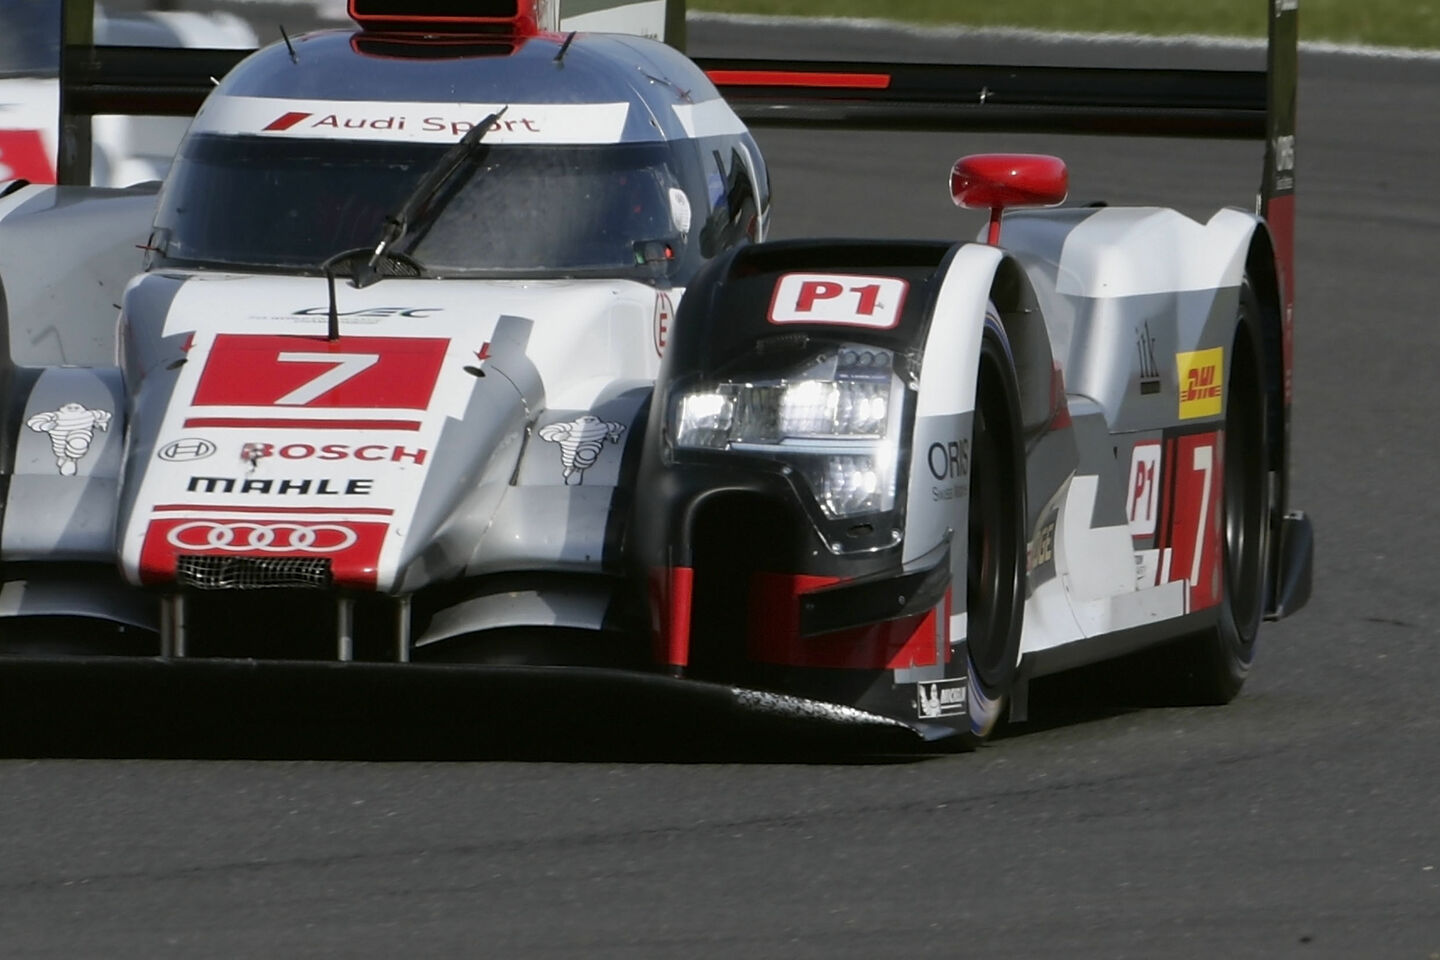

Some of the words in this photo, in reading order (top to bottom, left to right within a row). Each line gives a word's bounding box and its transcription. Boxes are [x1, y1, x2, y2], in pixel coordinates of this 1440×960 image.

[311, 114, 406, 130] Audi
[422, 116, 540, 136] Sport
[794, 281, 882, 316] P1
[272, 351, 381, 406] 7
[1183, 365, 1219, 402] DHL
[240, 442, 428, 466] BOSCH
[186, 476, 375, 496] MAHLE
[1130, 459, 1156, 522] P1
[1190, 445, 1213, 587] 7
